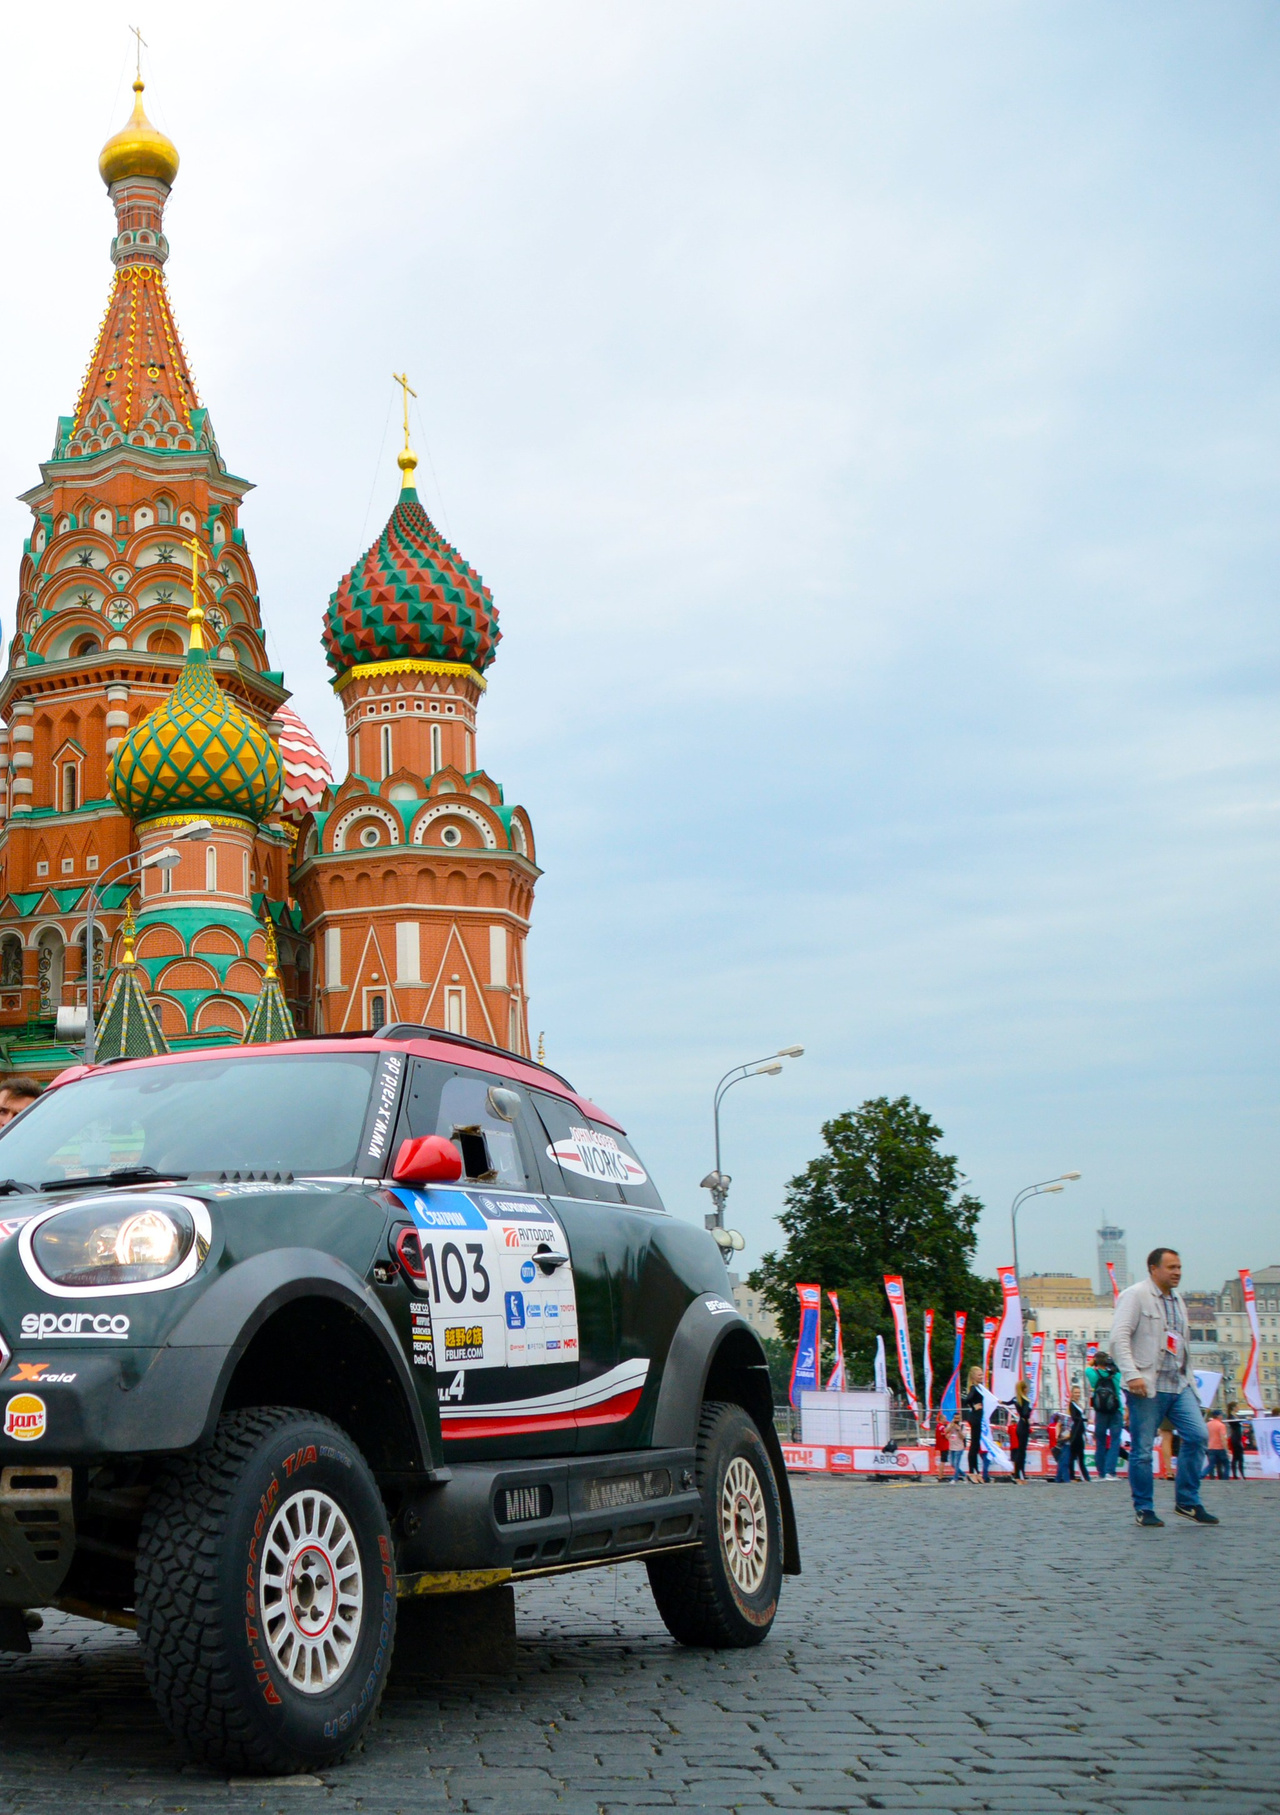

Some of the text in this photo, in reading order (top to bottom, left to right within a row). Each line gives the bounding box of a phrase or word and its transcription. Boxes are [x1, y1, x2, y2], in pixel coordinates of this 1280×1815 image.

[368, 1056, 402, 1159] www.x-raid.de
[576, 1144, 629, 1181] WORKS
[434, 1211, 468, 1226] GAZPROM
[518, 1227, 556, 1242] AVTODOR
[422, 1242, 490, 1304] 103
[21, 1312, 130, 1340] sparco
[413, 1341, 433, 1351] RECARO
[446, 1347, 483, 1360] FBLIFE.COM
[282, 1444, 318, 1478] T/A
[505, 1487, 541, 1521] MINI
[600, 1480, 644, 1508] MAGNA
